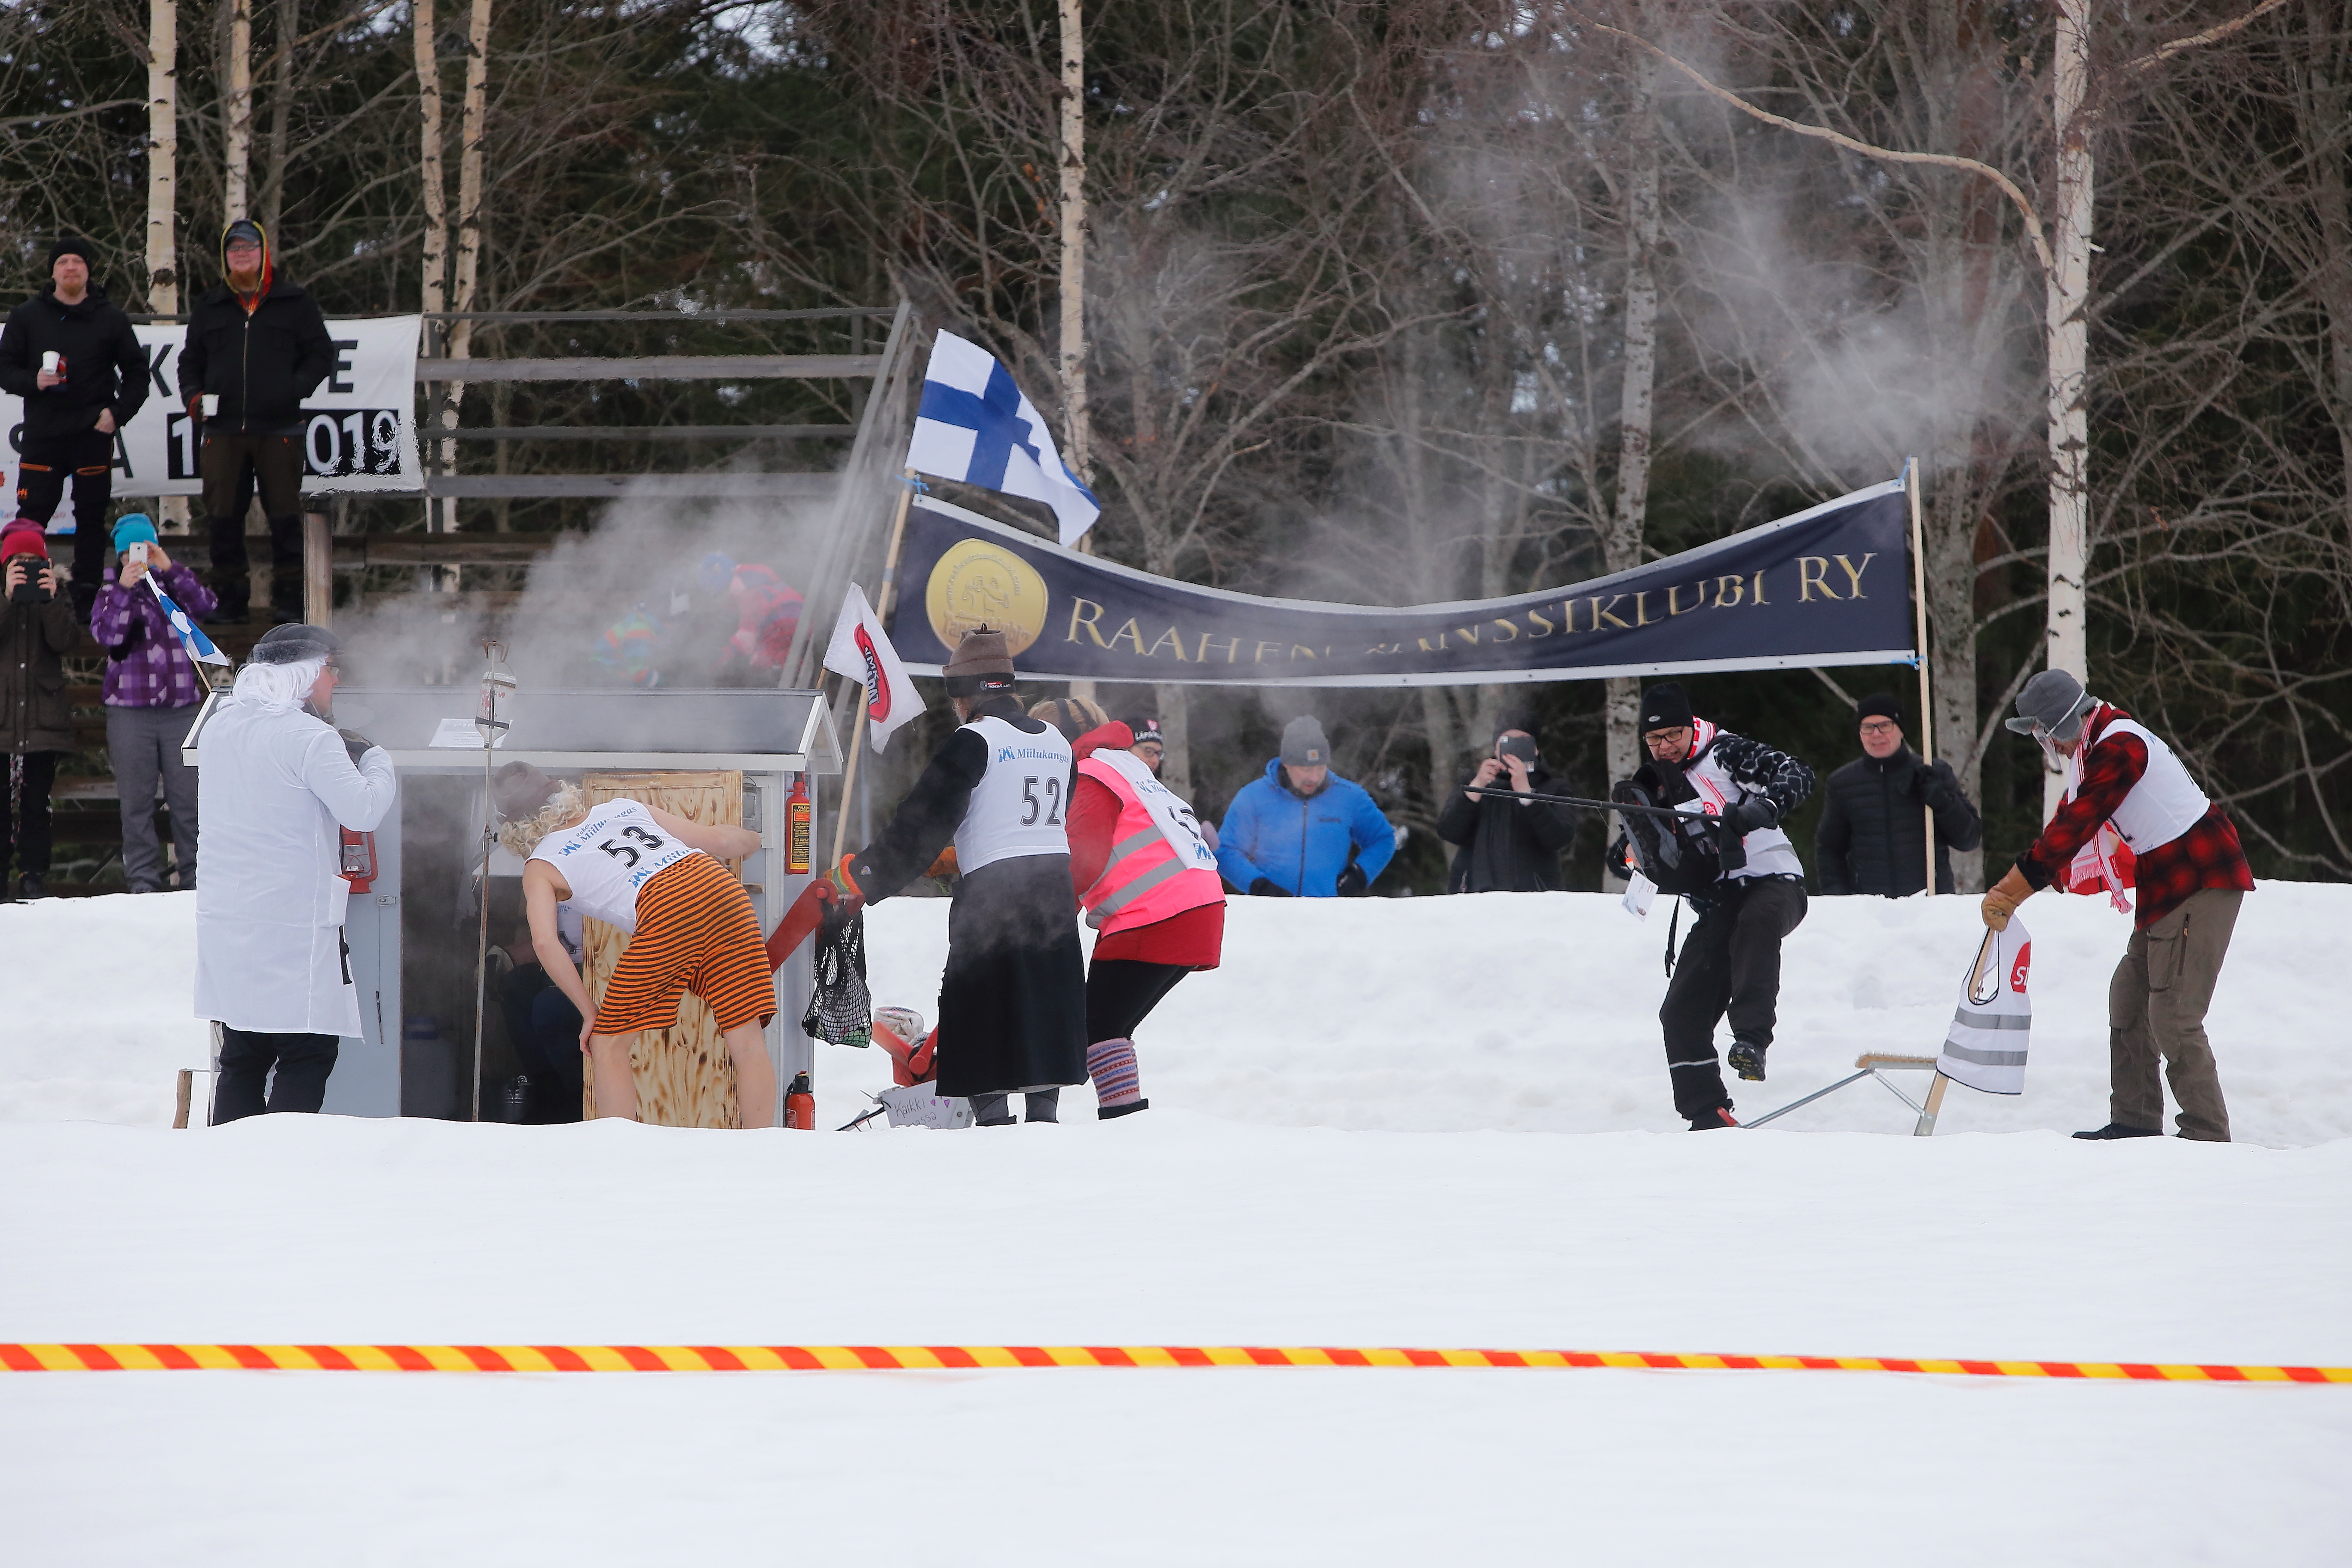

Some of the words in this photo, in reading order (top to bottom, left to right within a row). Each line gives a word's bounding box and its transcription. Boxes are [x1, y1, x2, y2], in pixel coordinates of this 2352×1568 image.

[303, 409, 402, 476] 019
[1063, 594, 1332, 665] RAAHEN
[1795, 552, 1878, 603] RY
[1017, 748, 1069, 764] Miilukangas
[1020, 775, 1062, 827] 52
[597, 826, 665, 870] 53
